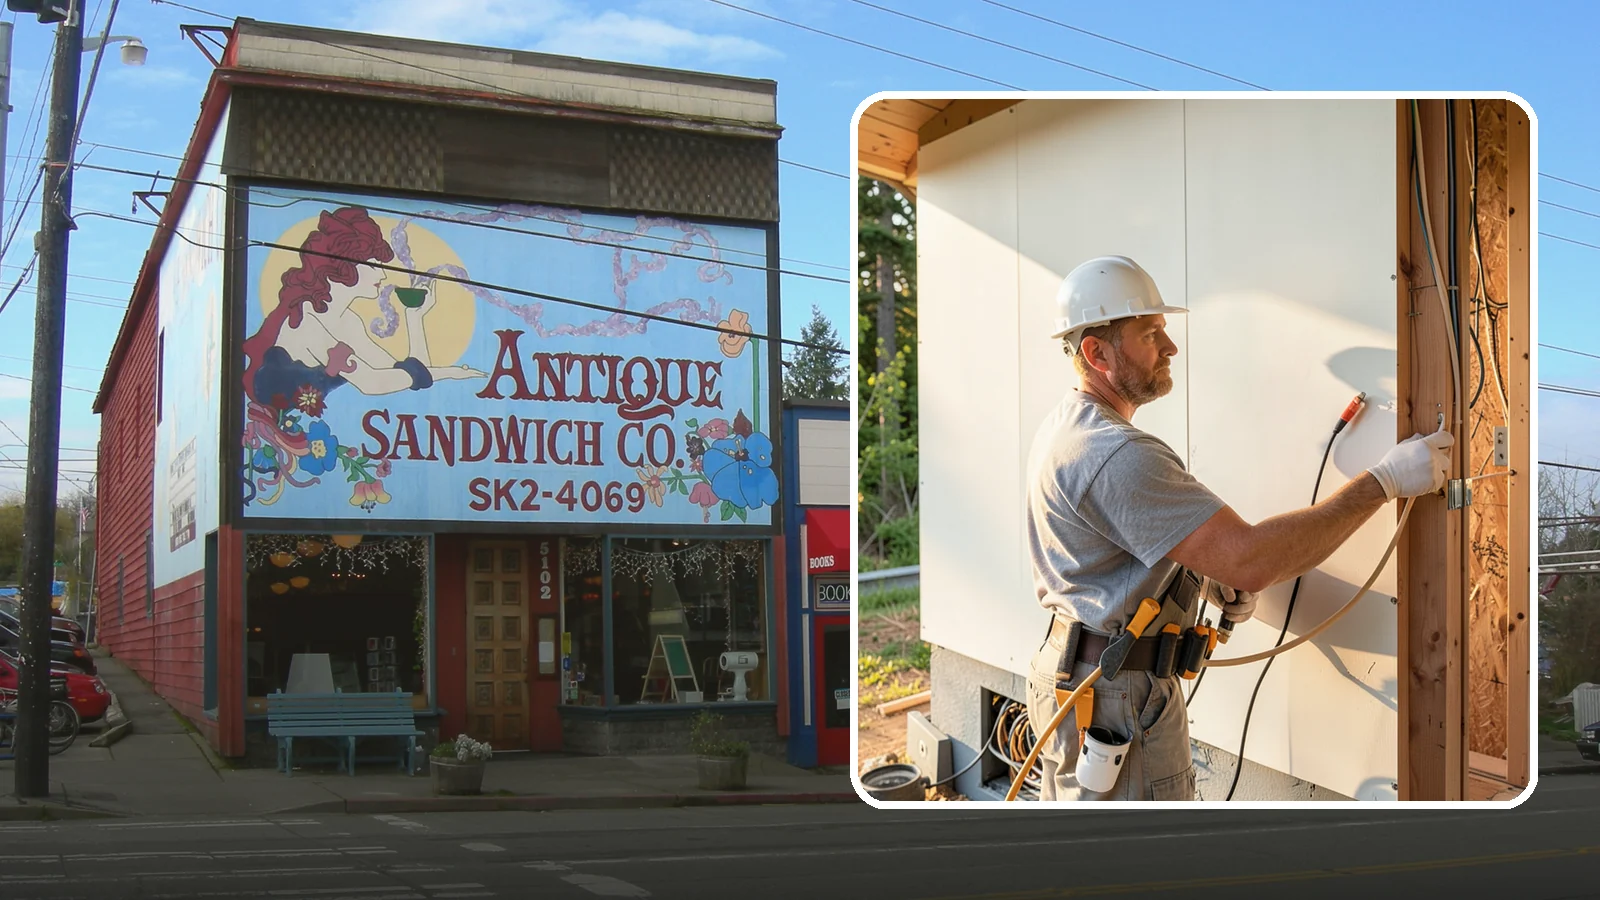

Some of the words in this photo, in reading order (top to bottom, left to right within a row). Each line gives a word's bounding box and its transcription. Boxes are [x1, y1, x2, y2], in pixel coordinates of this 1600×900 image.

[476, 330, 723, 421] ANTIQUE
[361, 408, 604, 467] SANDWICH
[617, 422, 685, 468] CO.
[468, 477, 645, 512] SK2-4069
[539, 542, 551, 599] 5102
[809, 555, 834, 568] BOOKS
